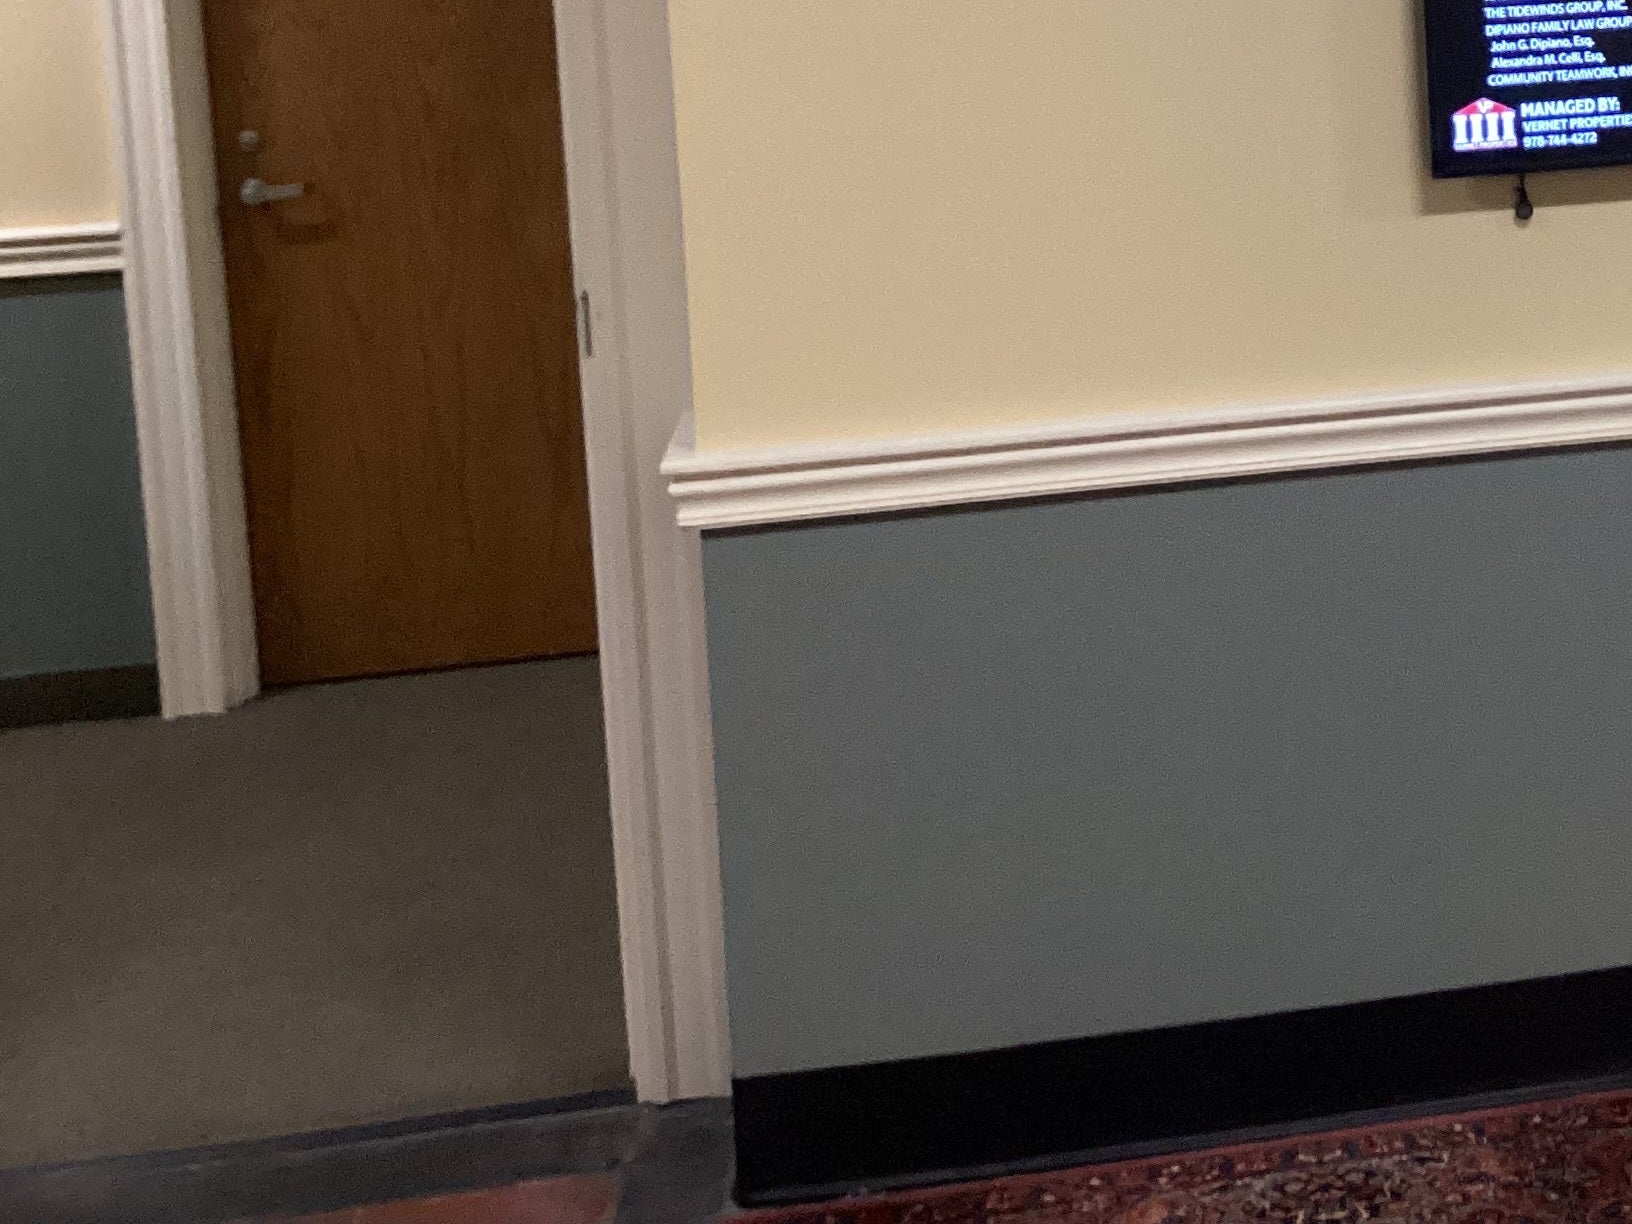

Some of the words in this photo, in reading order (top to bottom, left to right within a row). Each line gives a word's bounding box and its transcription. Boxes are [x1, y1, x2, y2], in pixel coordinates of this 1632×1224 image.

[1485, 6, 1506, 18] THE
[1507, 3, 1564, 17] TIDEWINDS
[1607, 0, 1628, 11] INC.
[1485, 23, 1530, 36] DIPIANO
[1531, 20, 1571, 33] FAMILY
[1571, 18, 1594, 30] LAW
[1490, 39, 1516, 52] John
[1573, 35, 1595, 48] Esq.
[1491, 55, 1543, 68] Alexandra
[1584, 51, 1606, 64] Esq.
[1487, 70, 1554, 86] COMMUNITY
[1521, 98, 1595, 117] MANAGED
[1597, 96, 1620, 111] BY:
[1522, 119, 1568, 132] VERNET
